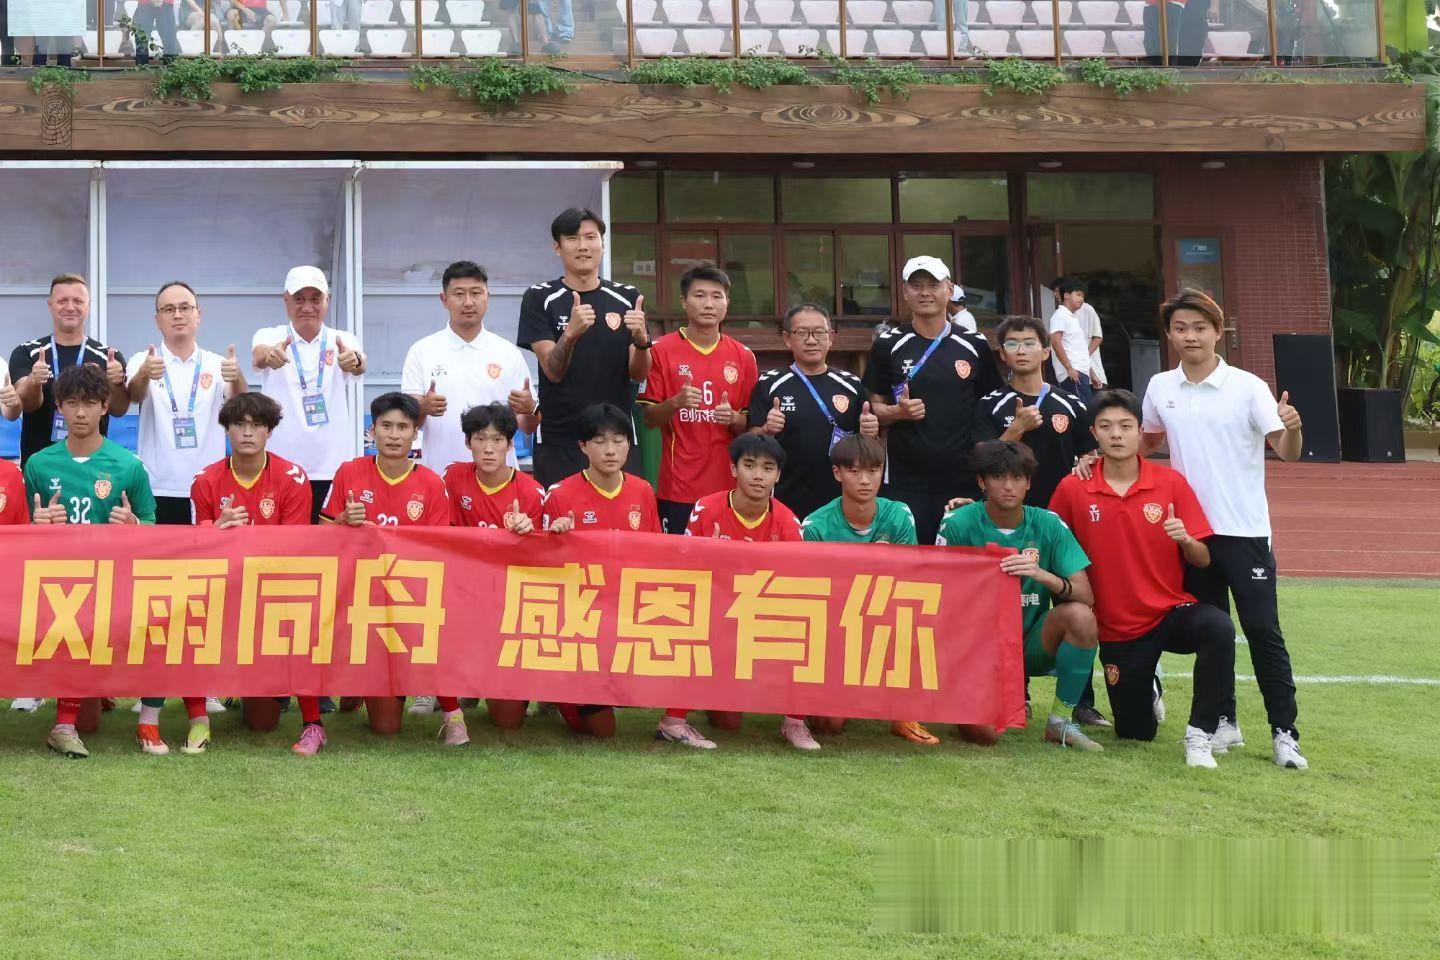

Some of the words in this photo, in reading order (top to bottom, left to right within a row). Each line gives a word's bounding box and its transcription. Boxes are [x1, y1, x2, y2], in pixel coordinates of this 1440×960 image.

[702, 381, 713, 405] 6
[69, 496, 92, 525] 32
[16, 553, 447, 666] 风雨同舟
[499, 562, 942, 690] 感恩有你
